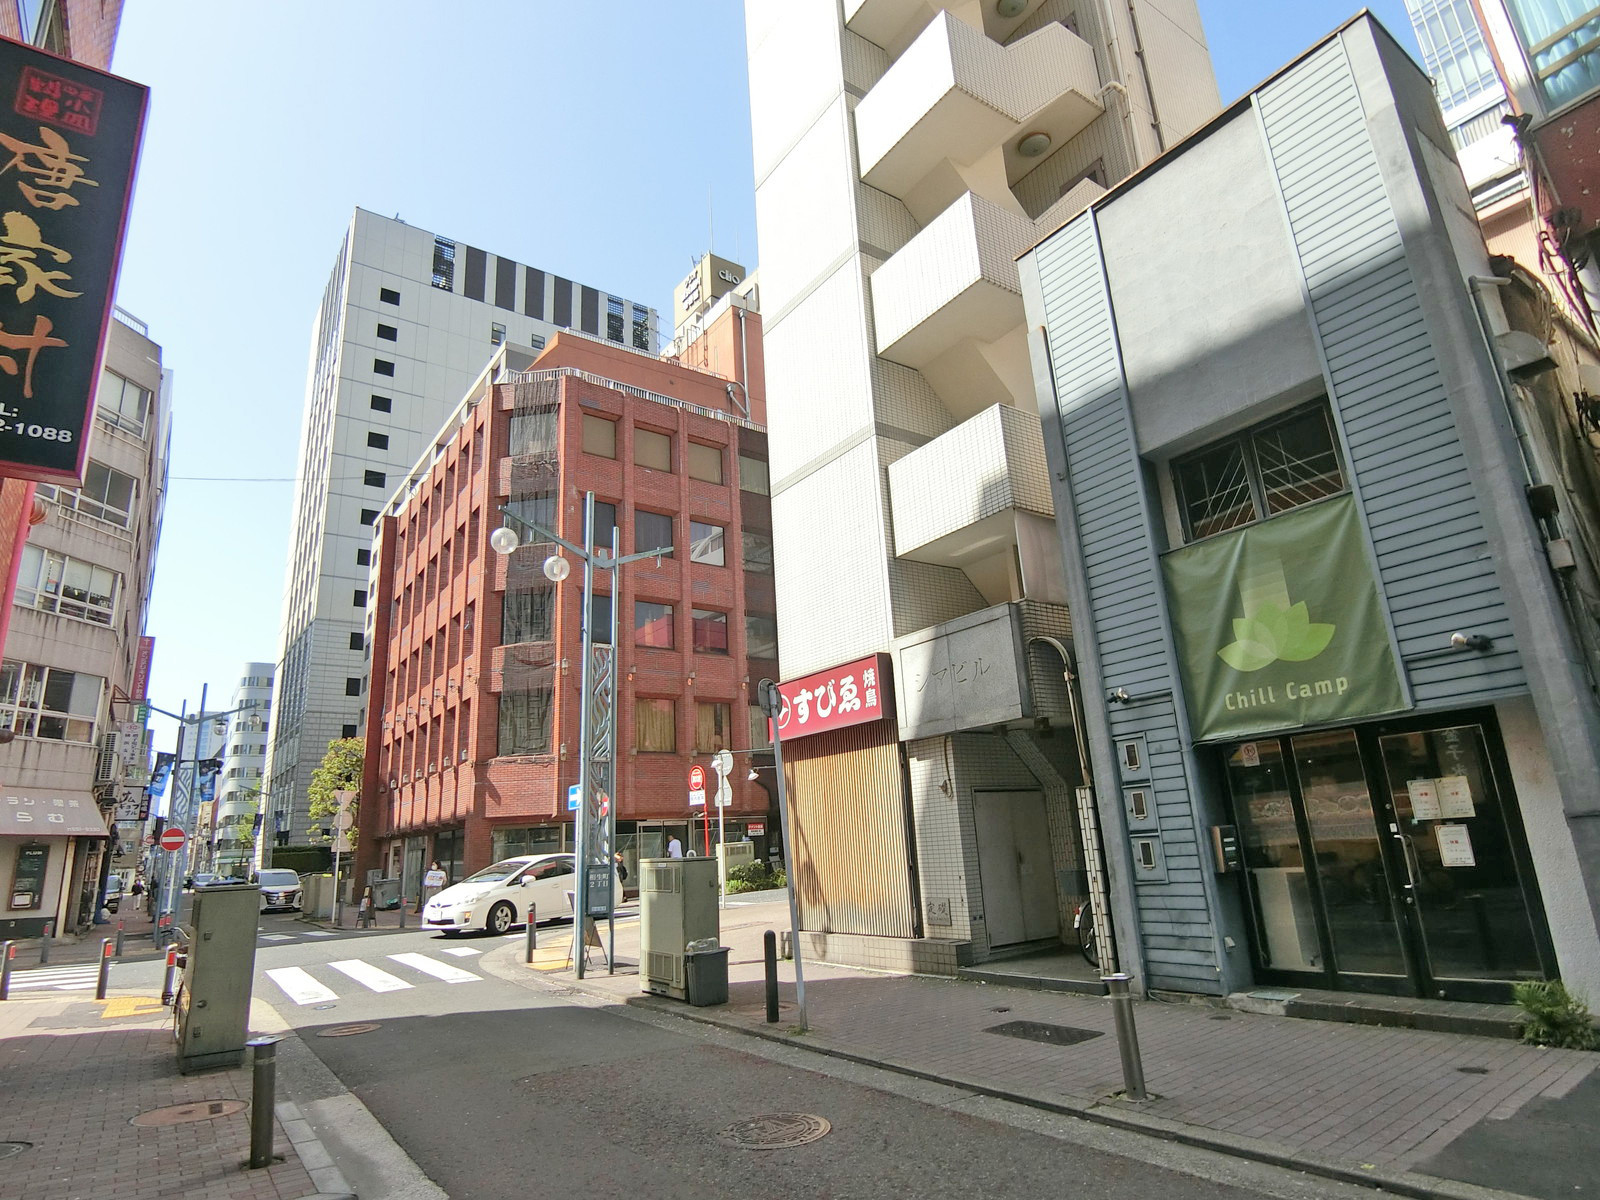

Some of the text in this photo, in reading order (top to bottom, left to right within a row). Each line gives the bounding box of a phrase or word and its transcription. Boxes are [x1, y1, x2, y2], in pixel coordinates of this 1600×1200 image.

[792, 674, 861, 725] すびゑ
[862, 667, 878, 709] 焼鳥
[1224, 676, 1349, 711] Chill Camp
